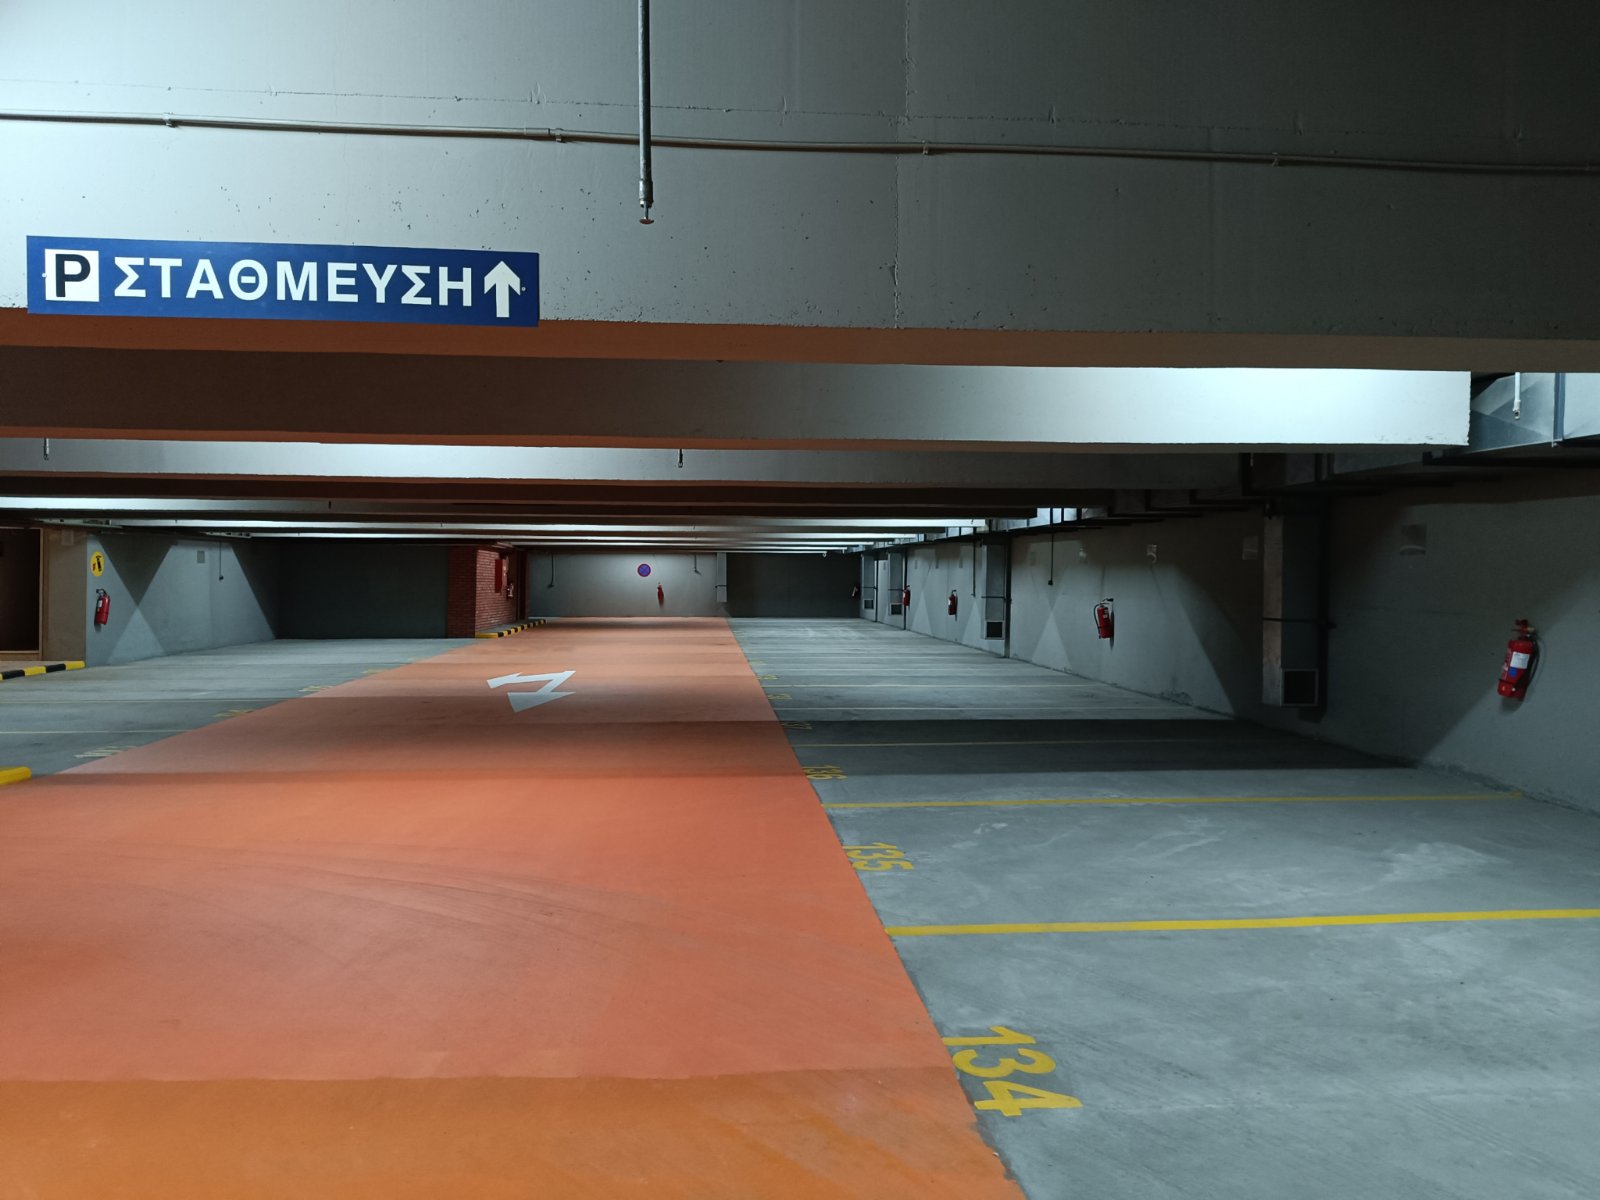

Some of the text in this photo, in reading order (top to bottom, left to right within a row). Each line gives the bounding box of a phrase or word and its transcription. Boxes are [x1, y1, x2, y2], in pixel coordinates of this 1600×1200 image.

[55, 253, 473, 307] P ΣΤΑΘΜΕΥΣΗ
[801, 764, 848, 780] 136
[842, 842, 914, 871] 135
[942, 1025, 1084, 1117] 134
